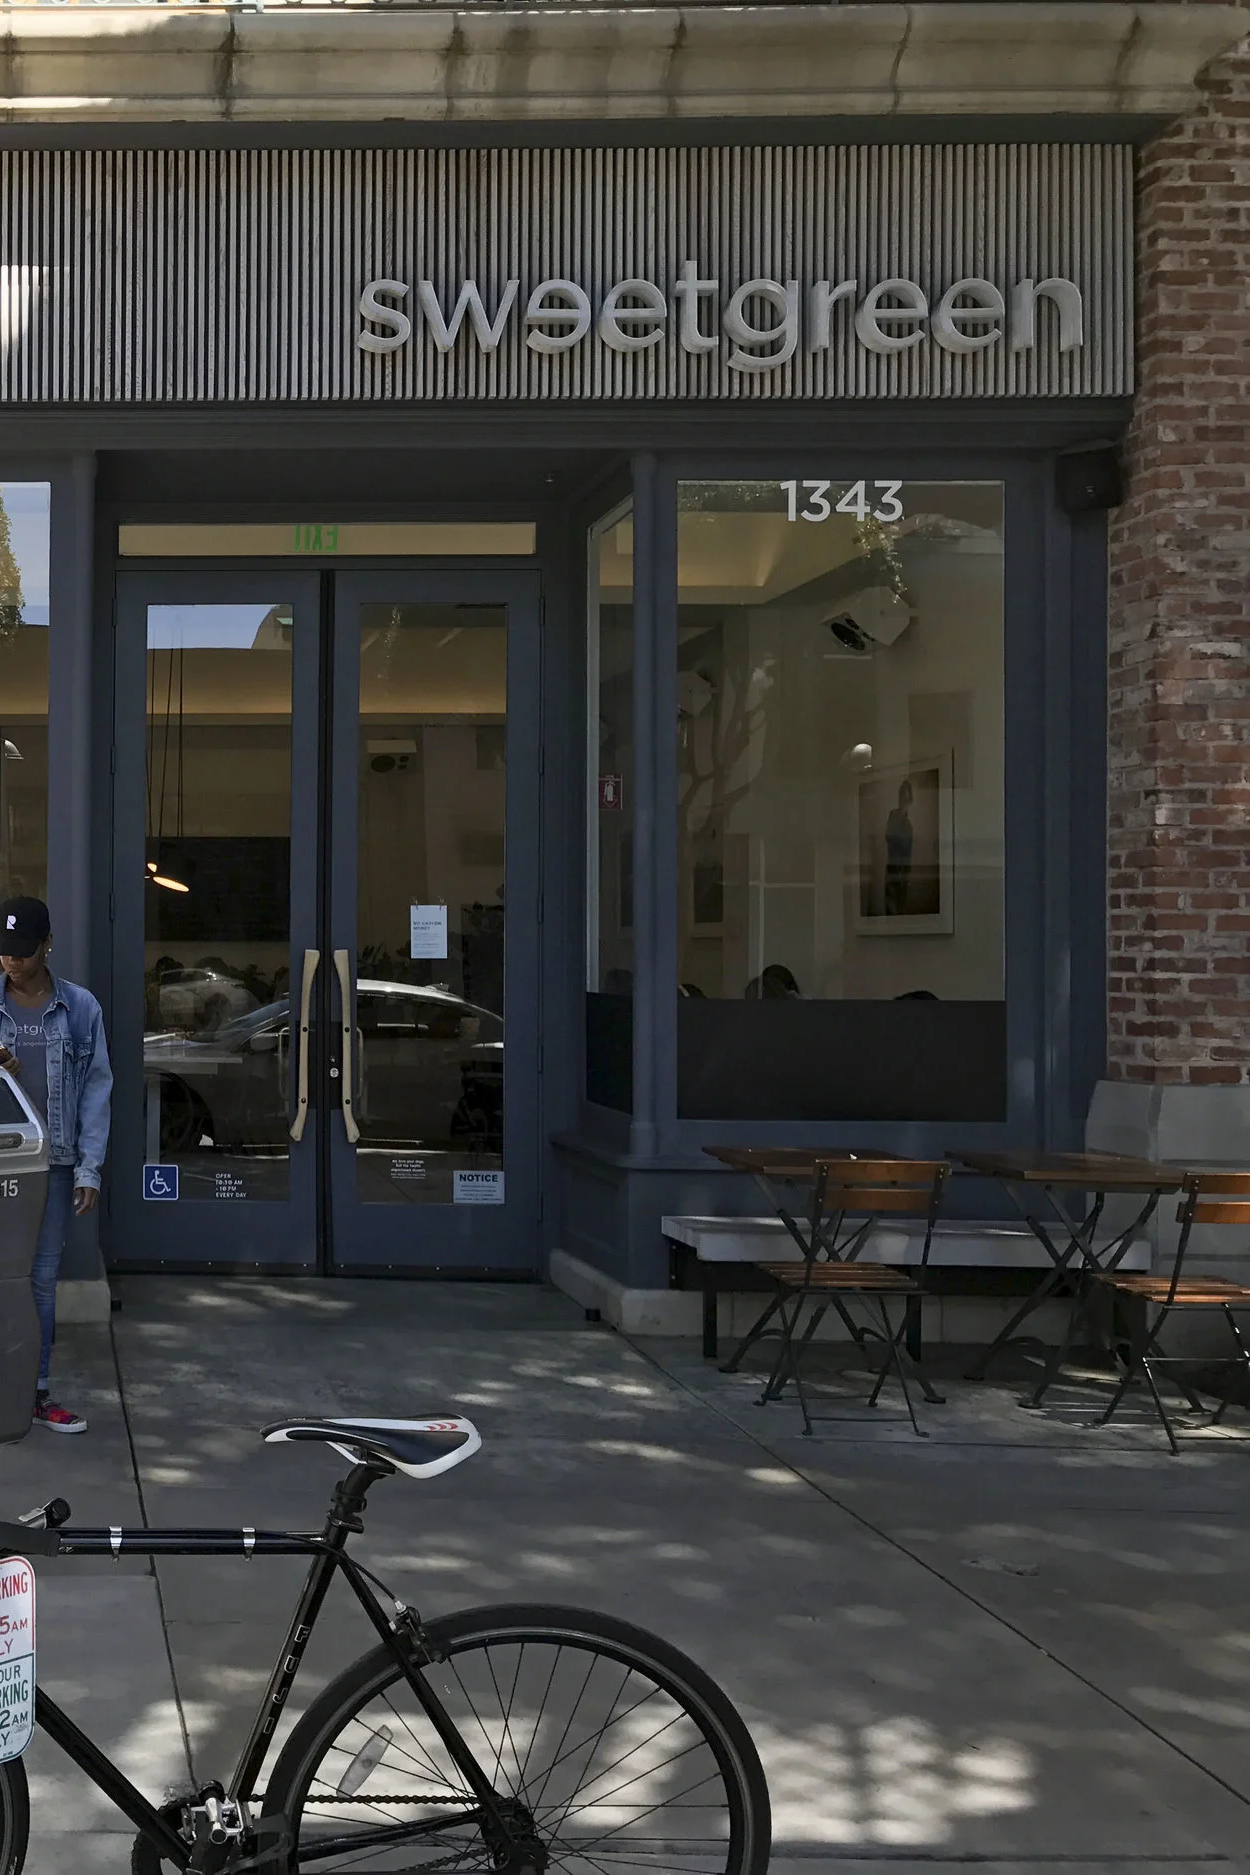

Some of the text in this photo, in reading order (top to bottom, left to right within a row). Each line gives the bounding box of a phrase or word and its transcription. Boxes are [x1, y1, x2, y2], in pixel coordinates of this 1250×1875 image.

[356, 260, 1085, 374] sweetgreen
[779, 480, 904, 522] 1343
[459, 1173, 499, 1182] NOTICE
[0, 1615, 28, 1635] 5AM
